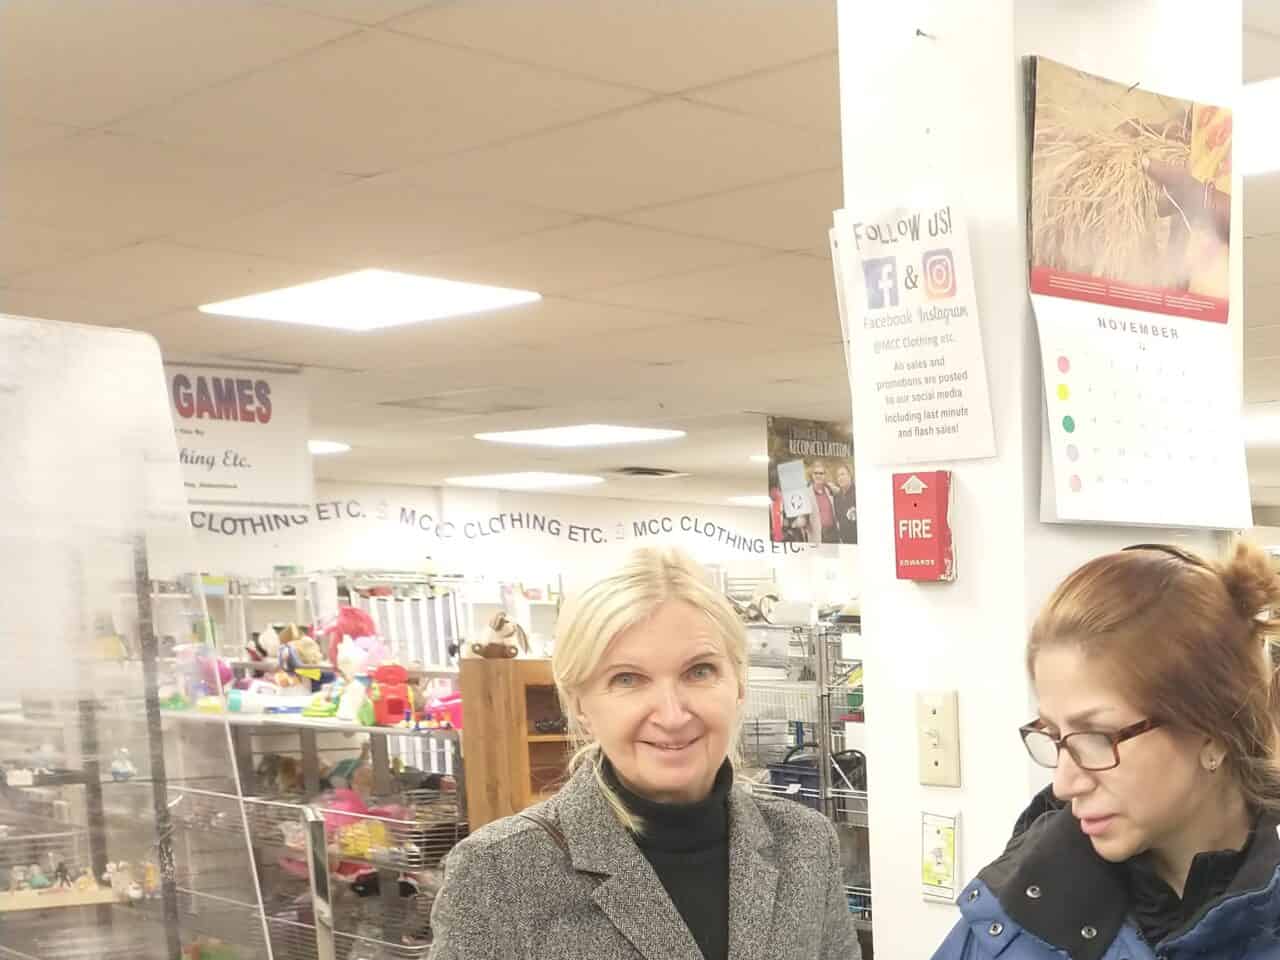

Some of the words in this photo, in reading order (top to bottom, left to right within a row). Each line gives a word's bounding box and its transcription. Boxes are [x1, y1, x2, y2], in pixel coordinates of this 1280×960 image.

[853, 214, 920, 250] FOLLOW
[928, 205, 952, 238] US!
[904, 265, 918, 290] &
[1097, 317, 1180, 340] NOVEMBER
[938, 370, 968, 385] posted
[172, 373, 272, 424] GAMES
[923, 409, 938, 420] last
[940, 407, 969, 418] minute
[179, 448, 216, 471] hing
[190, 510, 309, 536] CLOTHING
[316, 501, 367, 520] ETC.
[568, 524, 608, 543] ETC.
[633, 516, 673, 537] MCC
[680, 515, 765, 554] CLOTHING
[899, 519, 933, 539] FIRE
